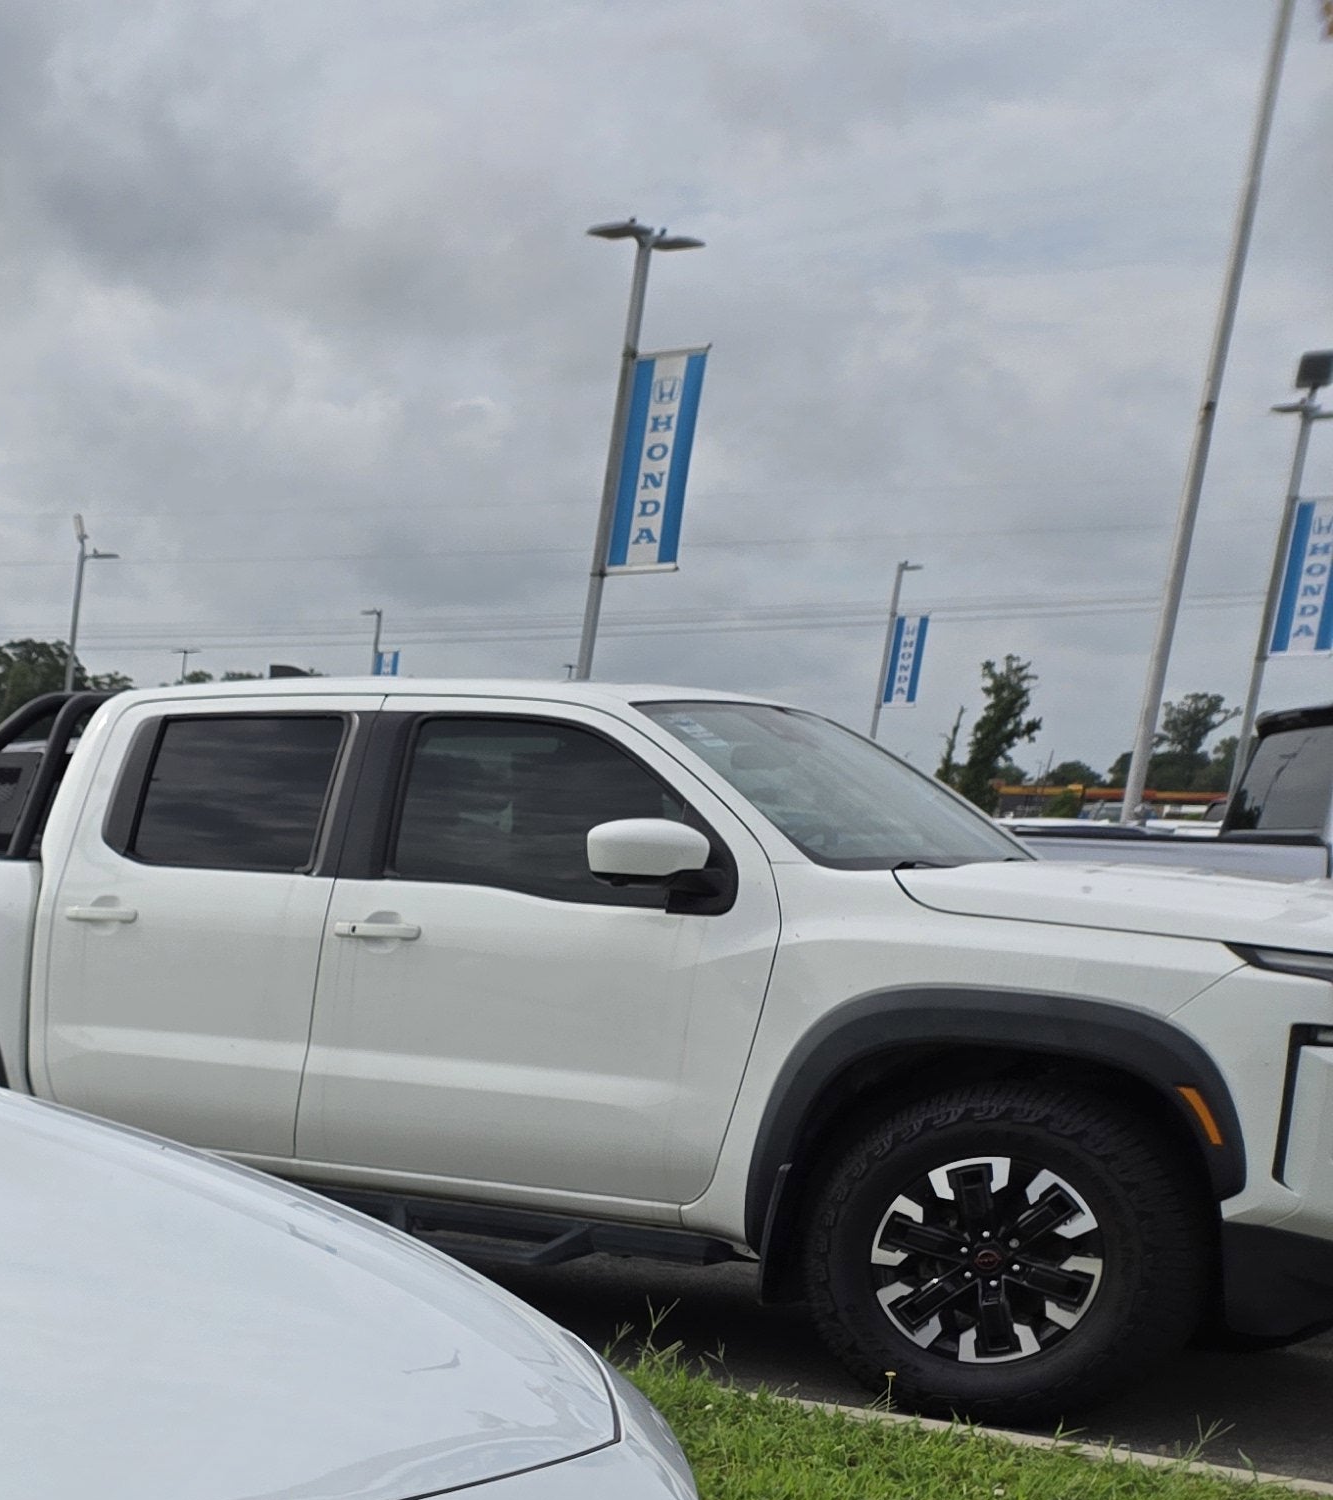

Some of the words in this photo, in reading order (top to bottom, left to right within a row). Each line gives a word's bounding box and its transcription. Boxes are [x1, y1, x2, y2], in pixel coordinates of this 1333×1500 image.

[632, 413, 675, 546] HONDA
[1293, 542, 1332, 638] HONDA
[895, 640, 915, 696] HONDA
